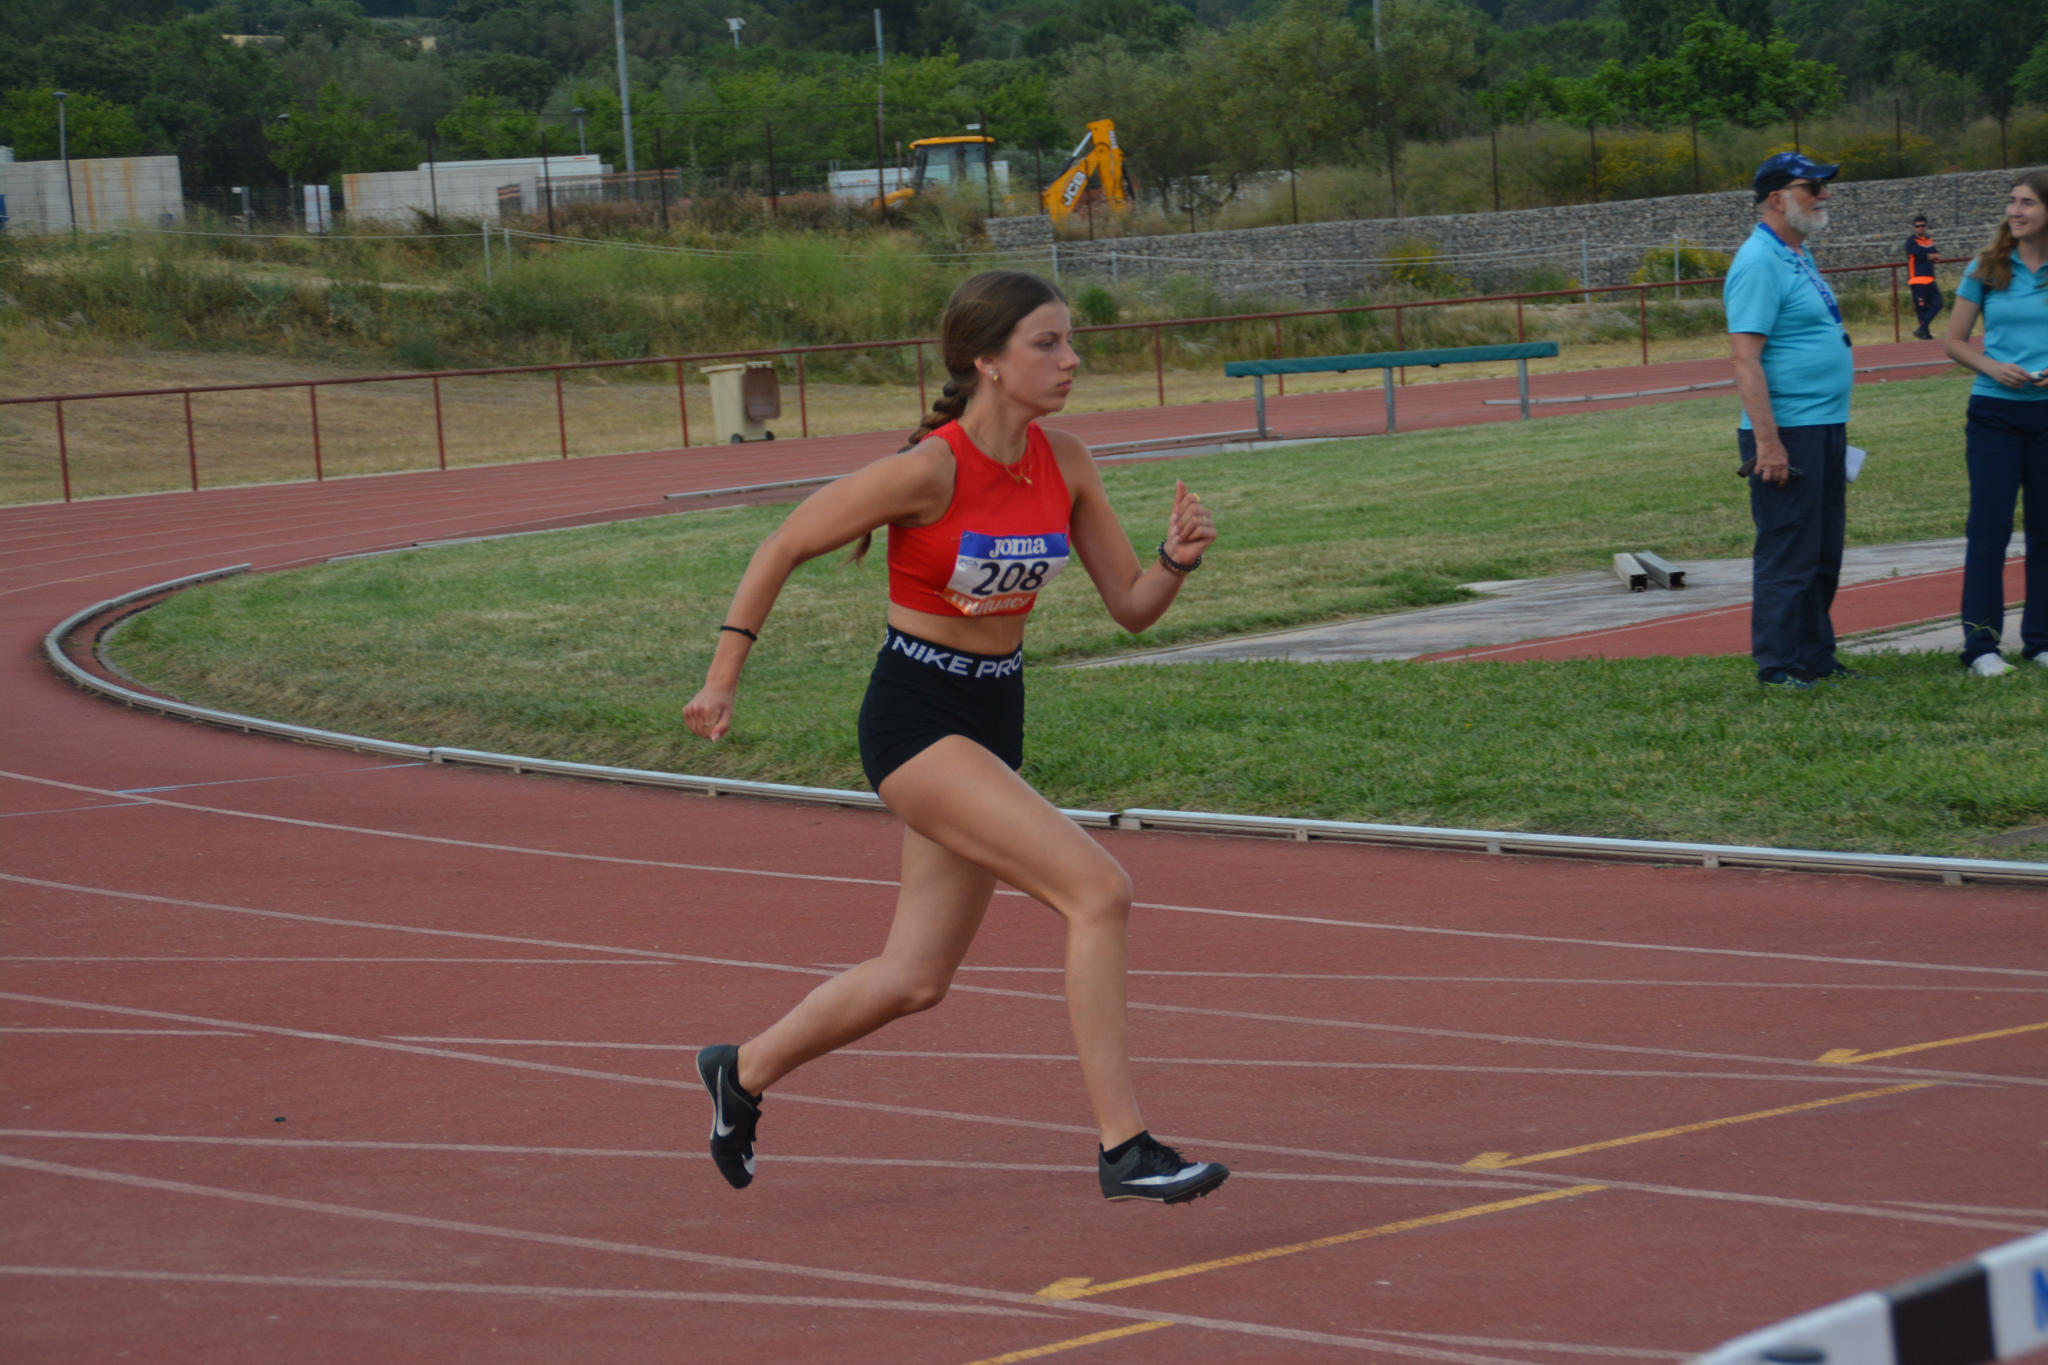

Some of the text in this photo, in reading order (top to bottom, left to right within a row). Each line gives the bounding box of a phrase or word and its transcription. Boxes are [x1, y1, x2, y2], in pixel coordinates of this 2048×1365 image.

[971, 561, 1049, 596] 208
[892, 635, 974, 676] NIKE
[975, 650, 1022, 678] PRO
